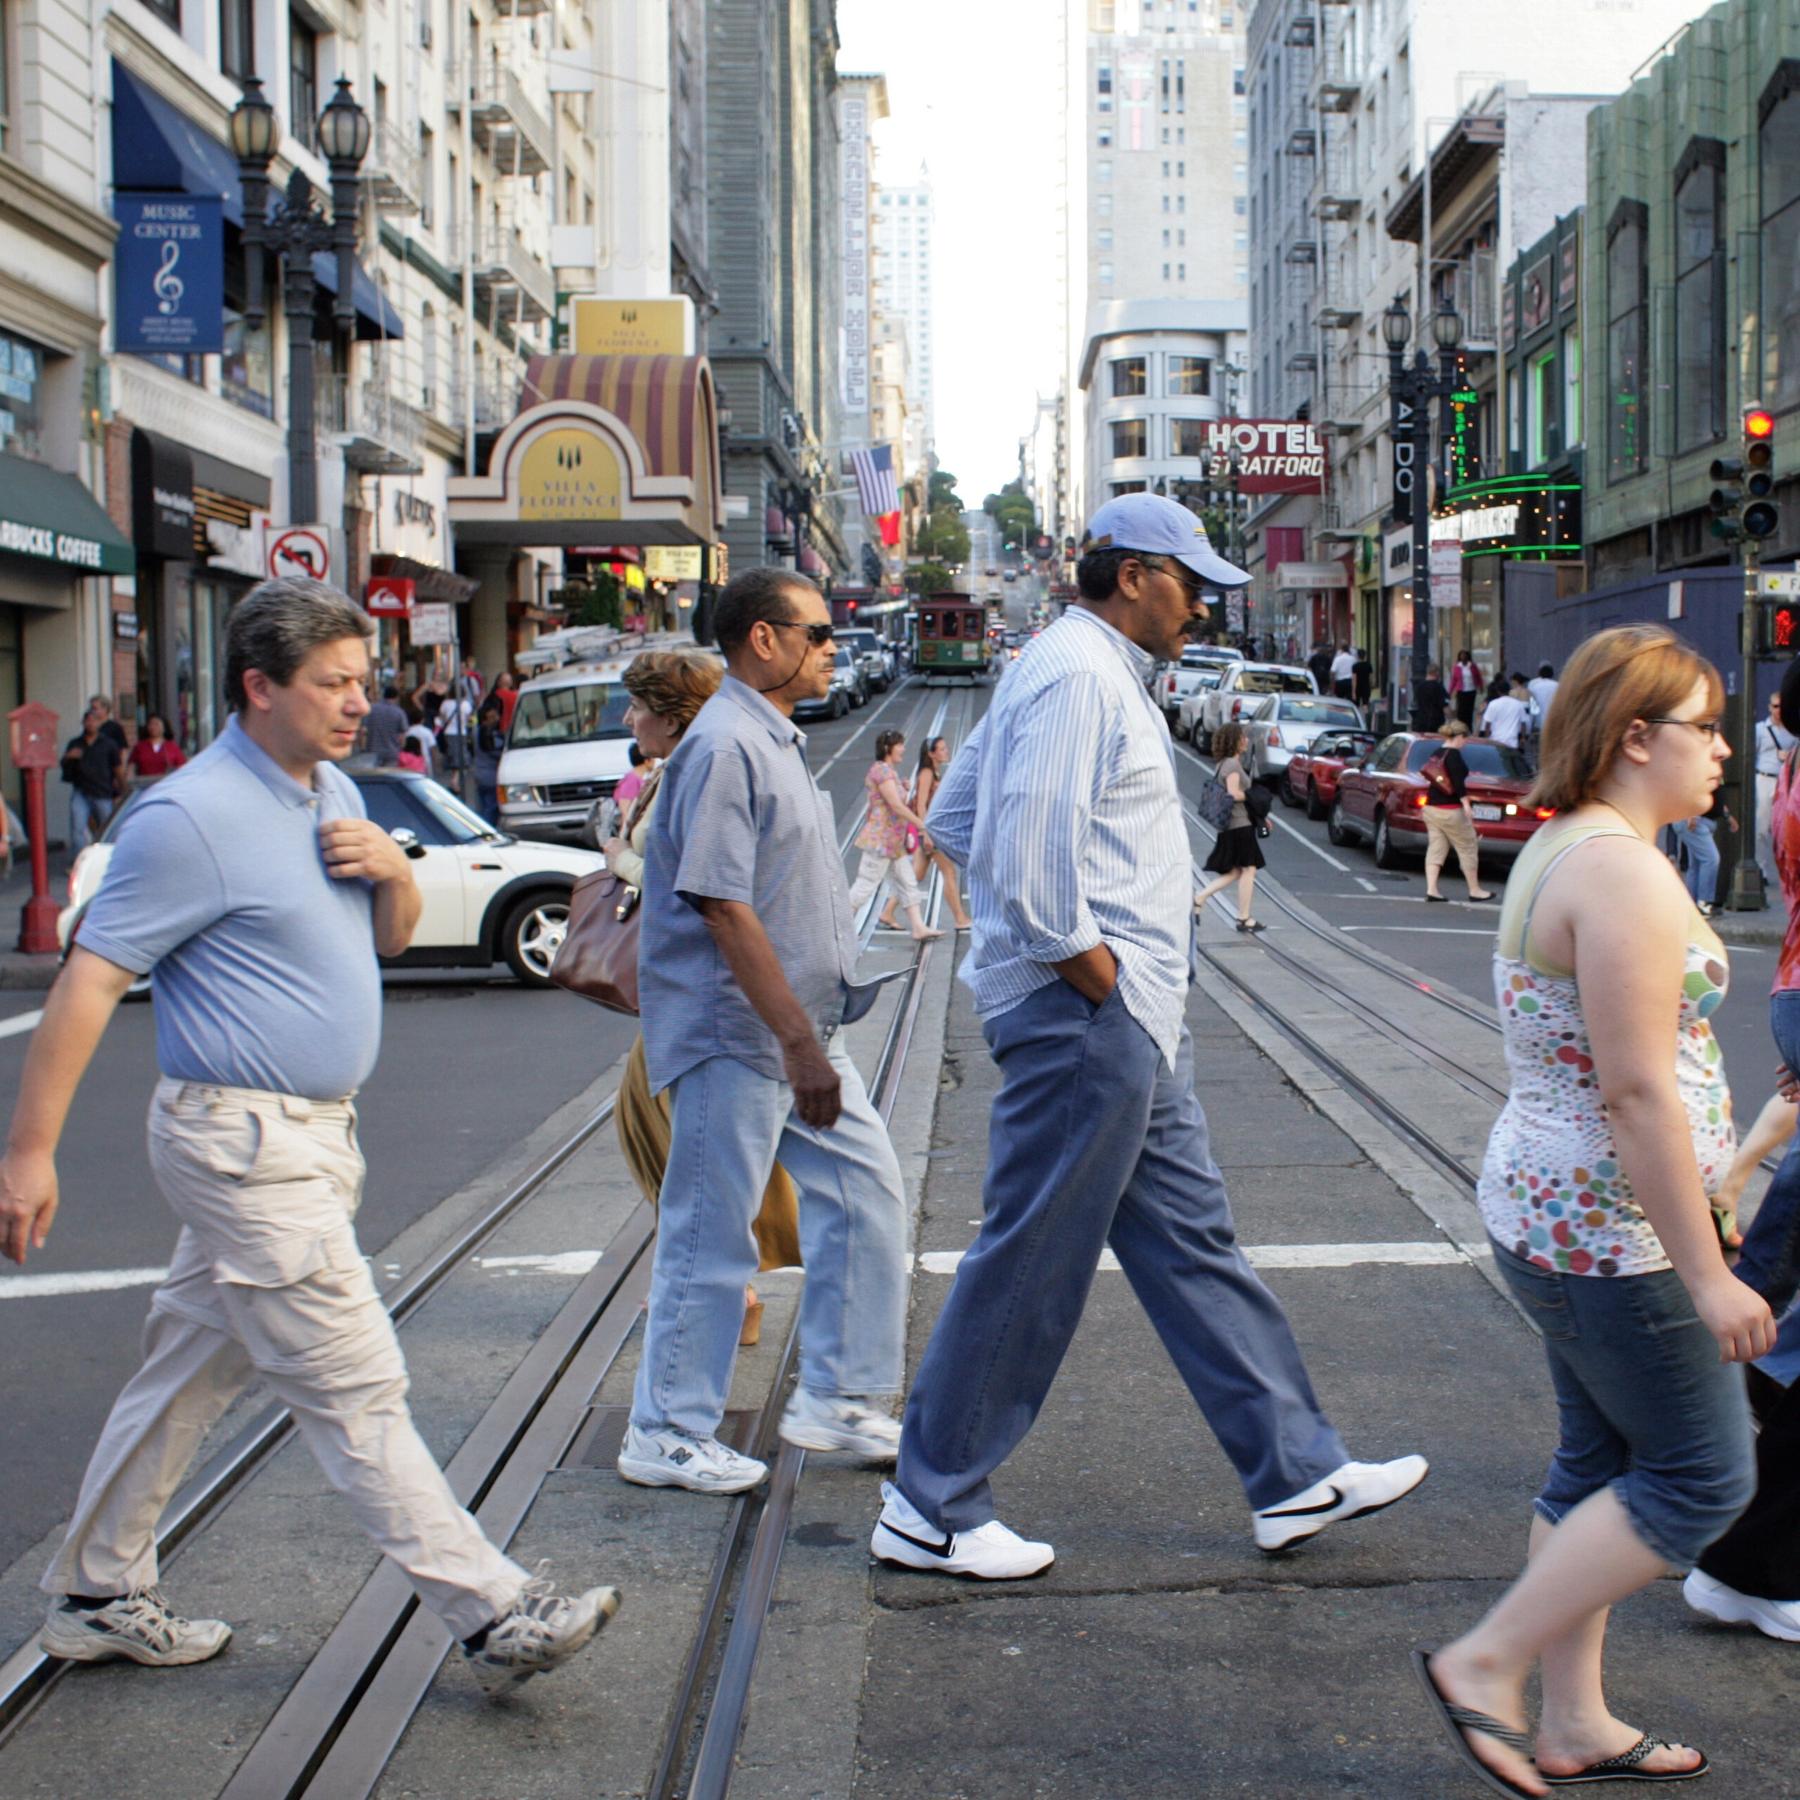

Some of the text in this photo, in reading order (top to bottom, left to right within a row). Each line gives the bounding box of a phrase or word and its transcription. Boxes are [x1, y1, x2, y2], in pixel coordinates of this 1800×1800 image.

[142, 204, 195, 220] MUSIC
[134, 223, 201, 239] CENTER
[845, 309, 866, 407] HOTEL
[1208, 423, 1325, 454] HOTEL
[1208, 455, 1325, 477] STRATFORD
[543, 481, 597, 492] VILLA
[56, 534, 102, 568] COFFEE
